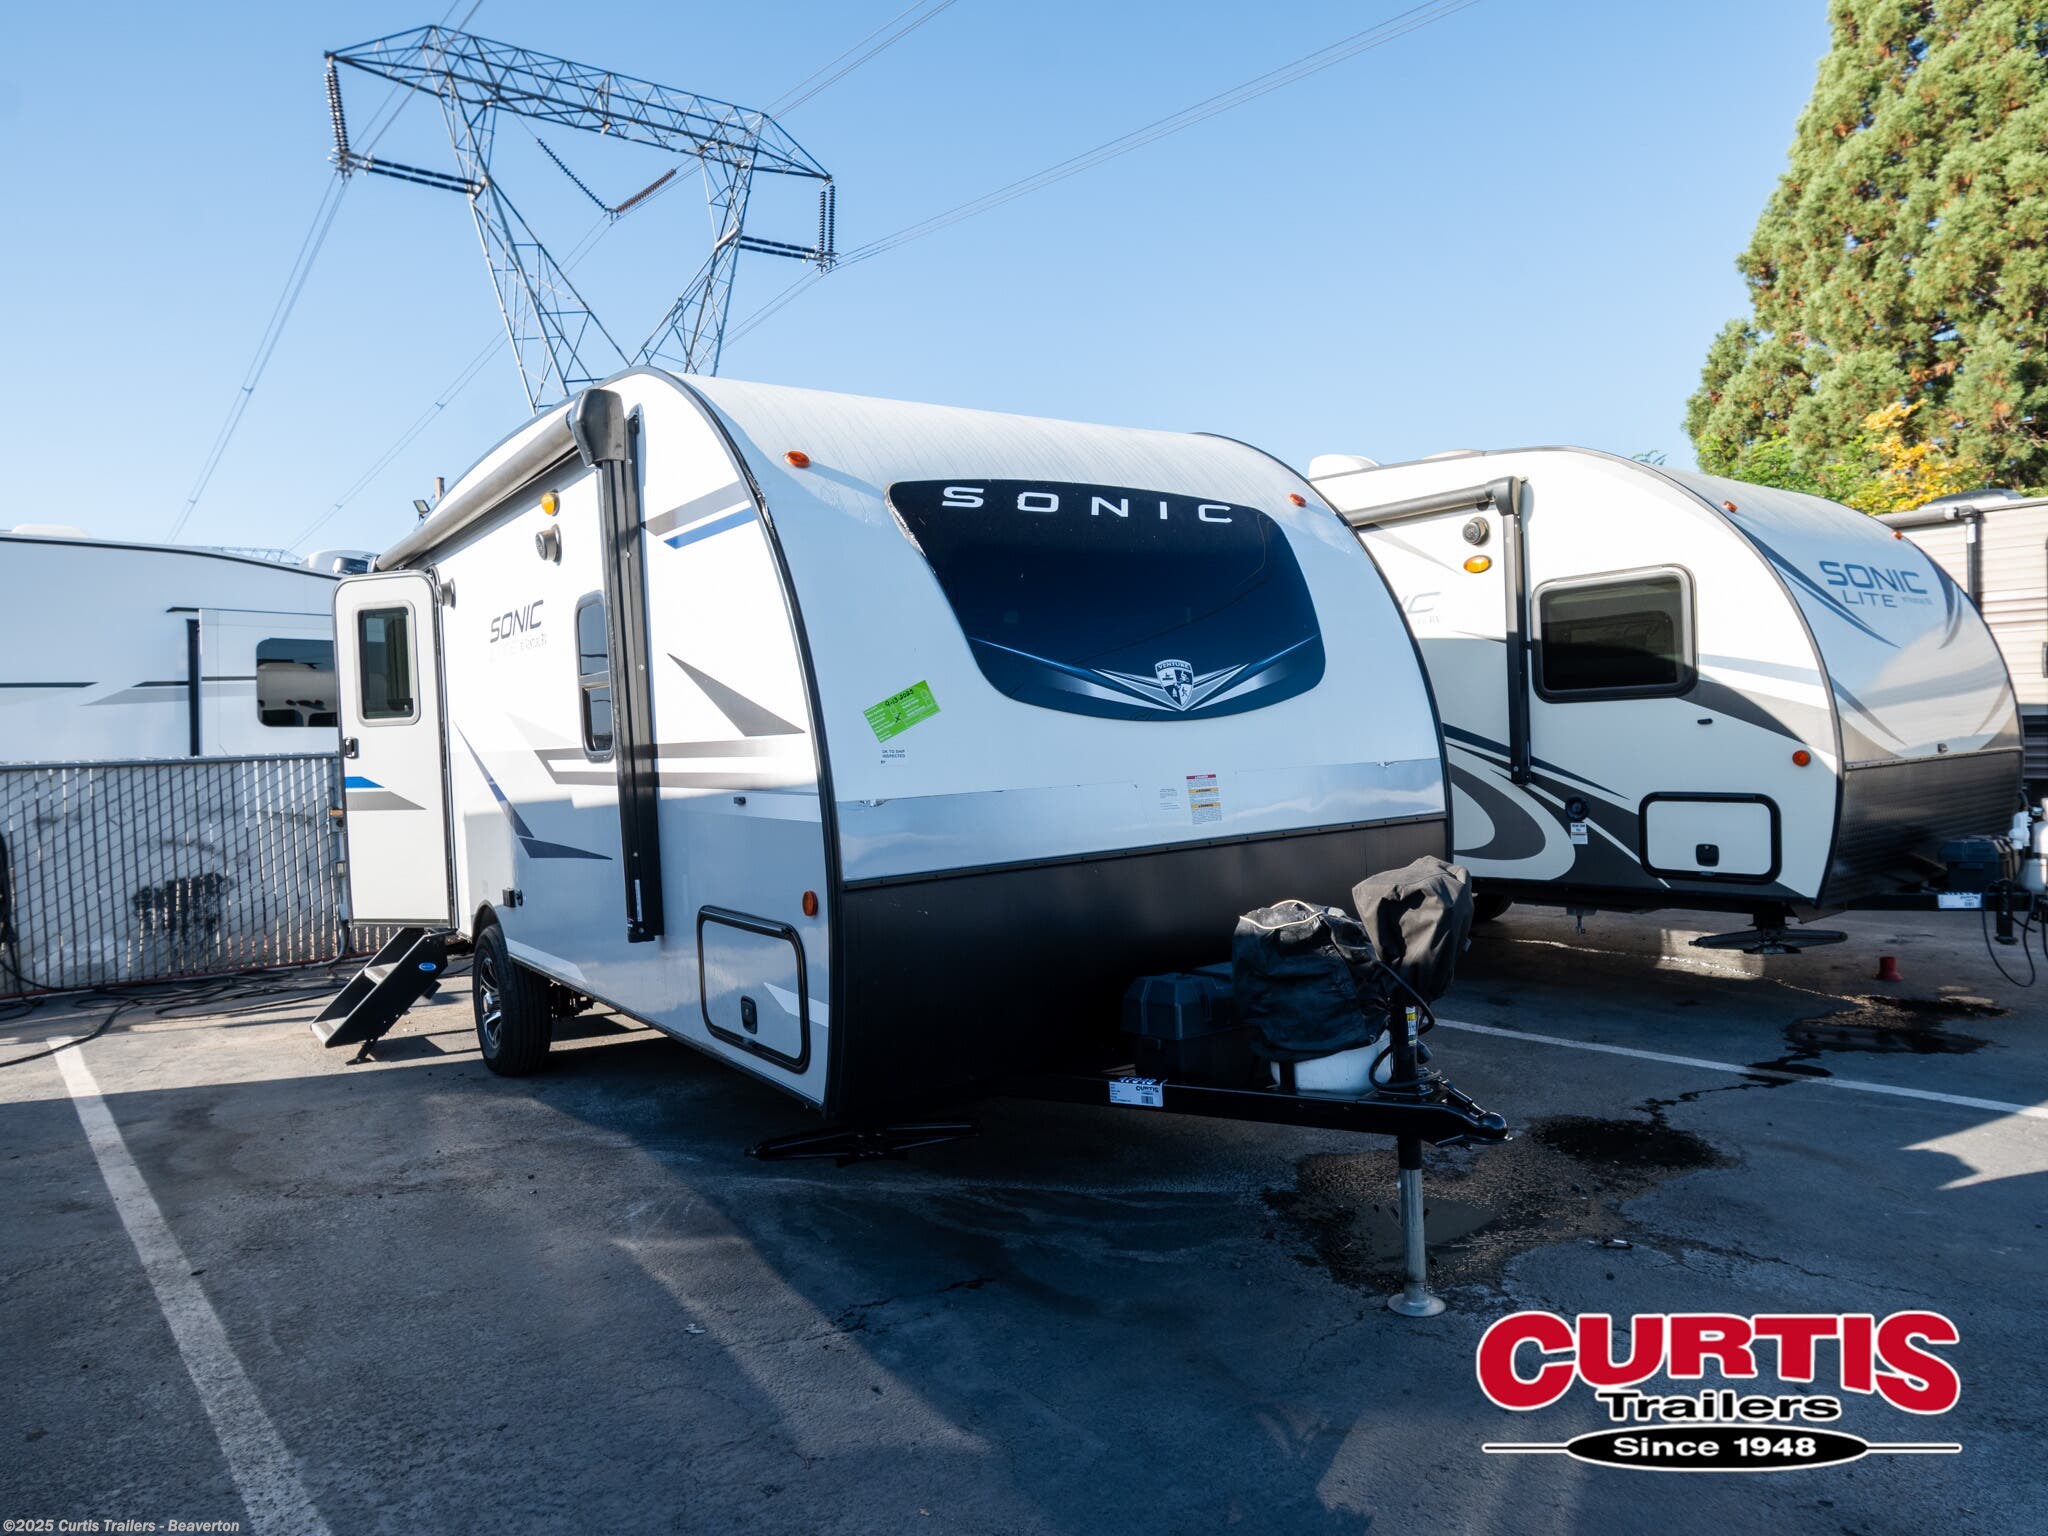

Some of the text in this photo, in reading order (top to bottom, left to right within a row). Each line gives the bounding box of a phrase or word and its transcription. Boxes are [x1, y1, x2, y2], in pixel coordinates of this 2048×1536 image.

[942, 486, 1232, 523] SONIC
[1819, 560, 1928, 594] SONIC
[1842, 589, 1898, 608] LITE
[490, 599, 544, 643] SONIC
